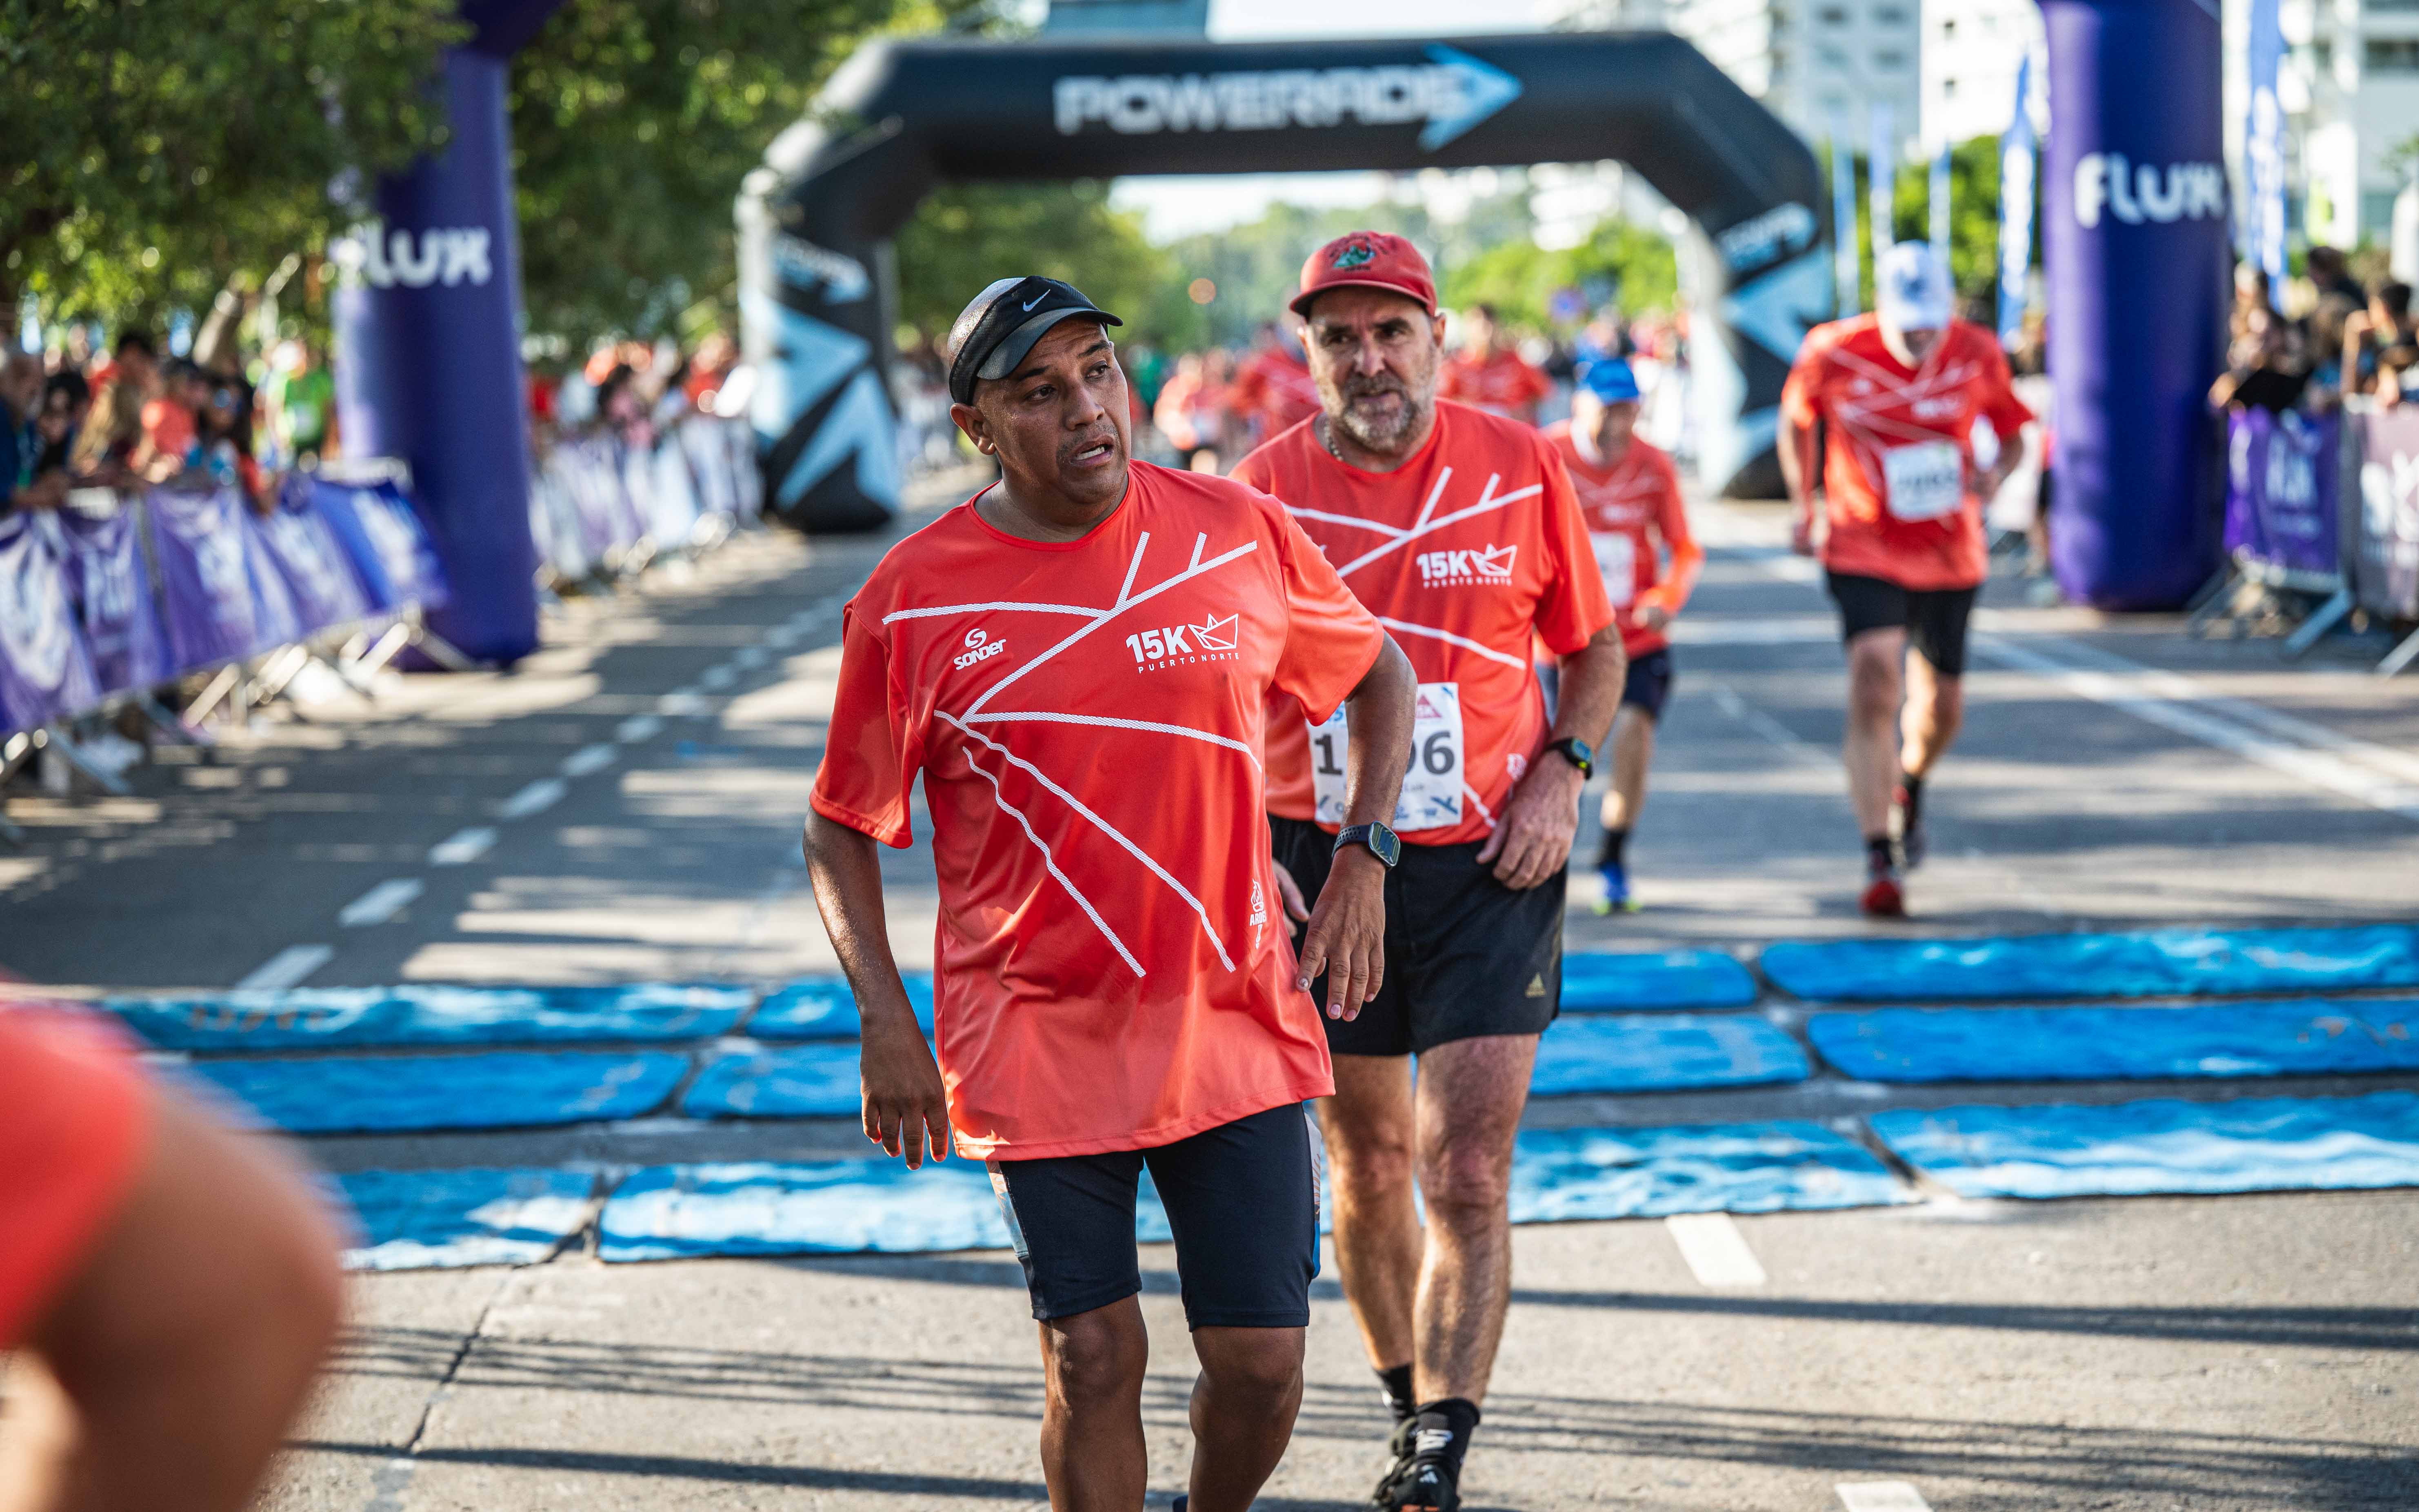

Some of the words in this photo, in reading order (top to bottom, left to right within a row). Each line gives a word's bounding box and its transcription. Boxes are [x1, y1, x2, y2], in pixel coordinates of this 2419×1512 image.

[1052, 64, 1471, 136] POWERADE
[1416, 550, 1472, 579] 15K
[1125, 625, 1193, 663] 15K
[1137, 655, 1195, 674] PUERTO
[1201, 653, 1239, 662] NORTE
[1314, 730, 1455, 776] 16
